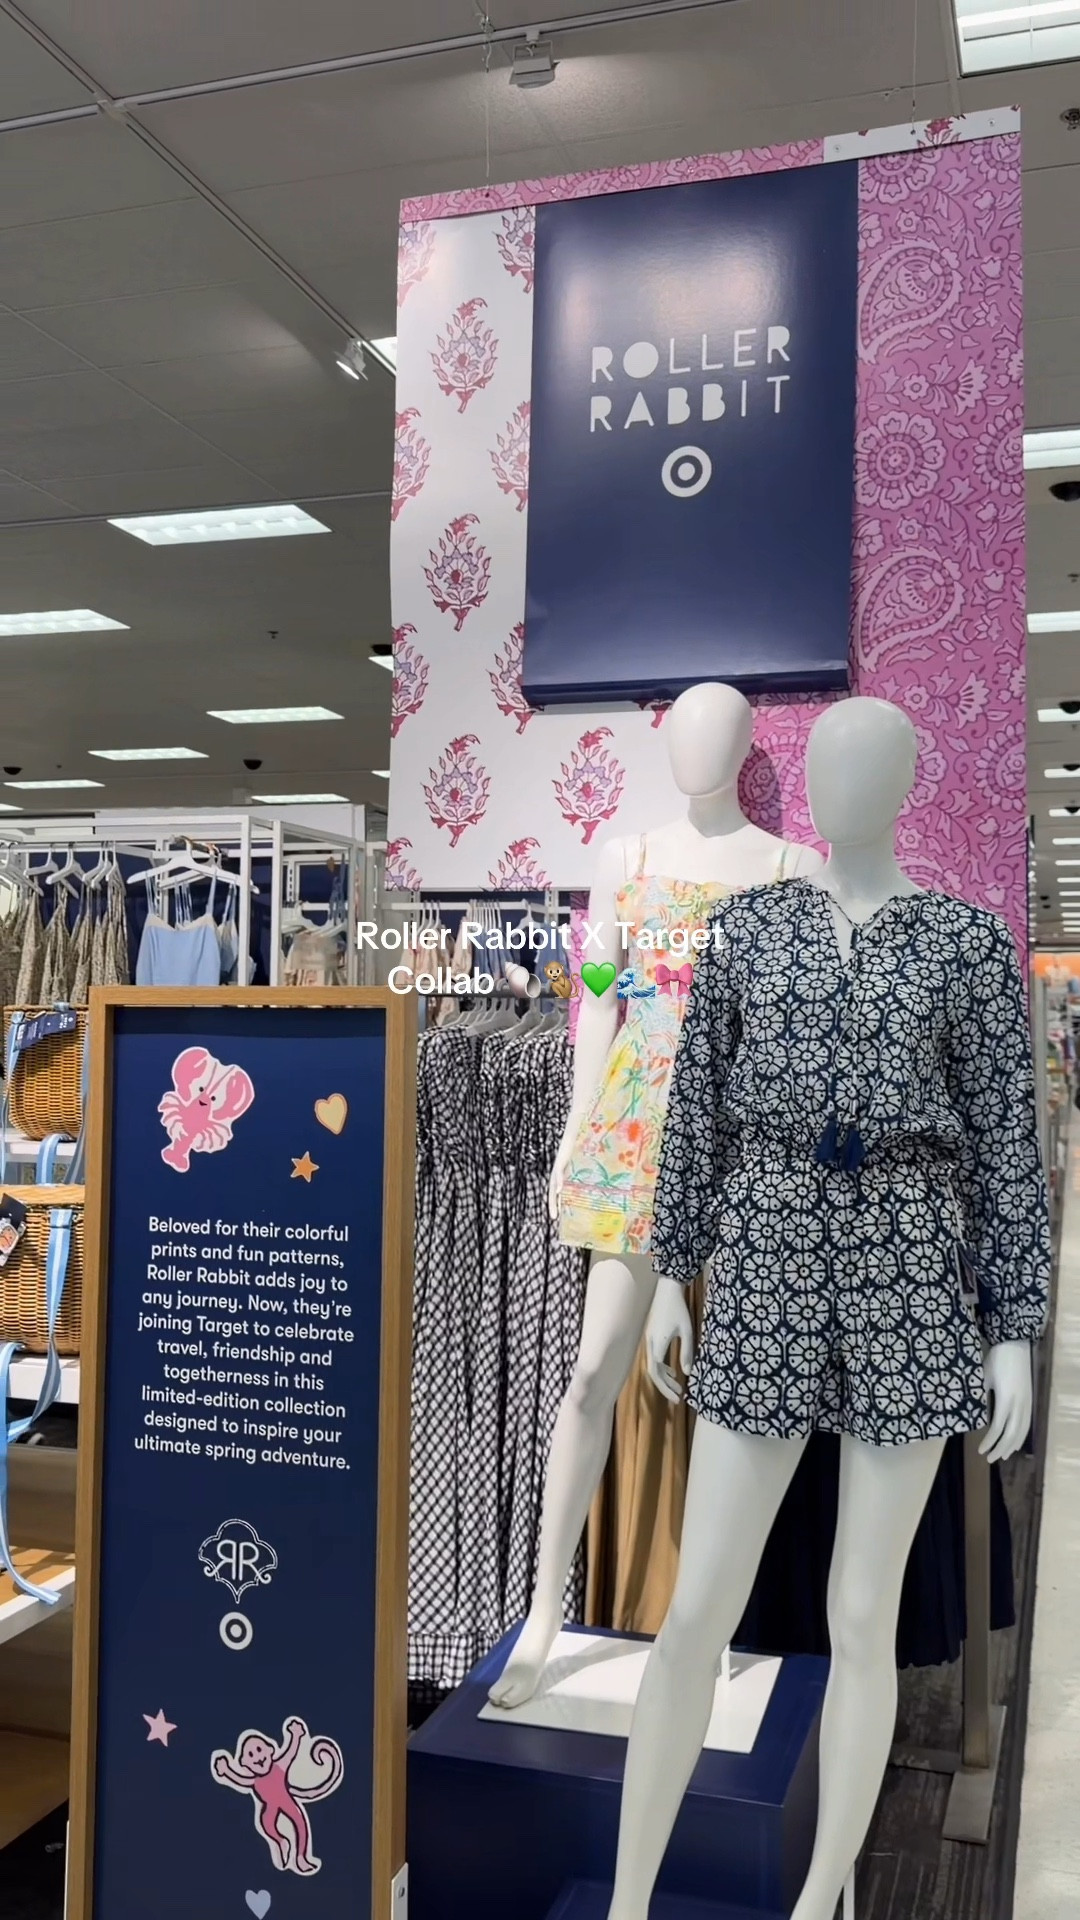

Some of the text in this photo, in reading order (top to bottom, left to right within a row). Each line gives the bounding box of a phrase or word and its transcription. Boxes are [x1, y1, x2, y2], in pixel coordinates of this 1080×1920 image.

[591, 325, 791, 384] ROLLER
[589, 374, 791, 433] RABBIT
[148, 1216, 349, 1242] Beloved for their colorful
[151, 1241, 345, 1269] prints and fun patterns,
[147, 1264, 348, 1295] Roller Rabbit adds joy to
[141, 1292, 173, 1310] any
[175, 1290, 243, 1313] journey.
[248, 1294, 288, 1315] Now,
[137, 1312, 355, 1344] joining Target to celebrate
[156, 1339, 333, 1367] travel, friendship and
[163, 1363, 325, 1391] togetherness in this
[141, 1384, 346, 1418] limited-edition collection
[143, 1410, 342, 1445] designed to inspire your
[134, 1433, 351, 1470] ultimate spring adventure.
